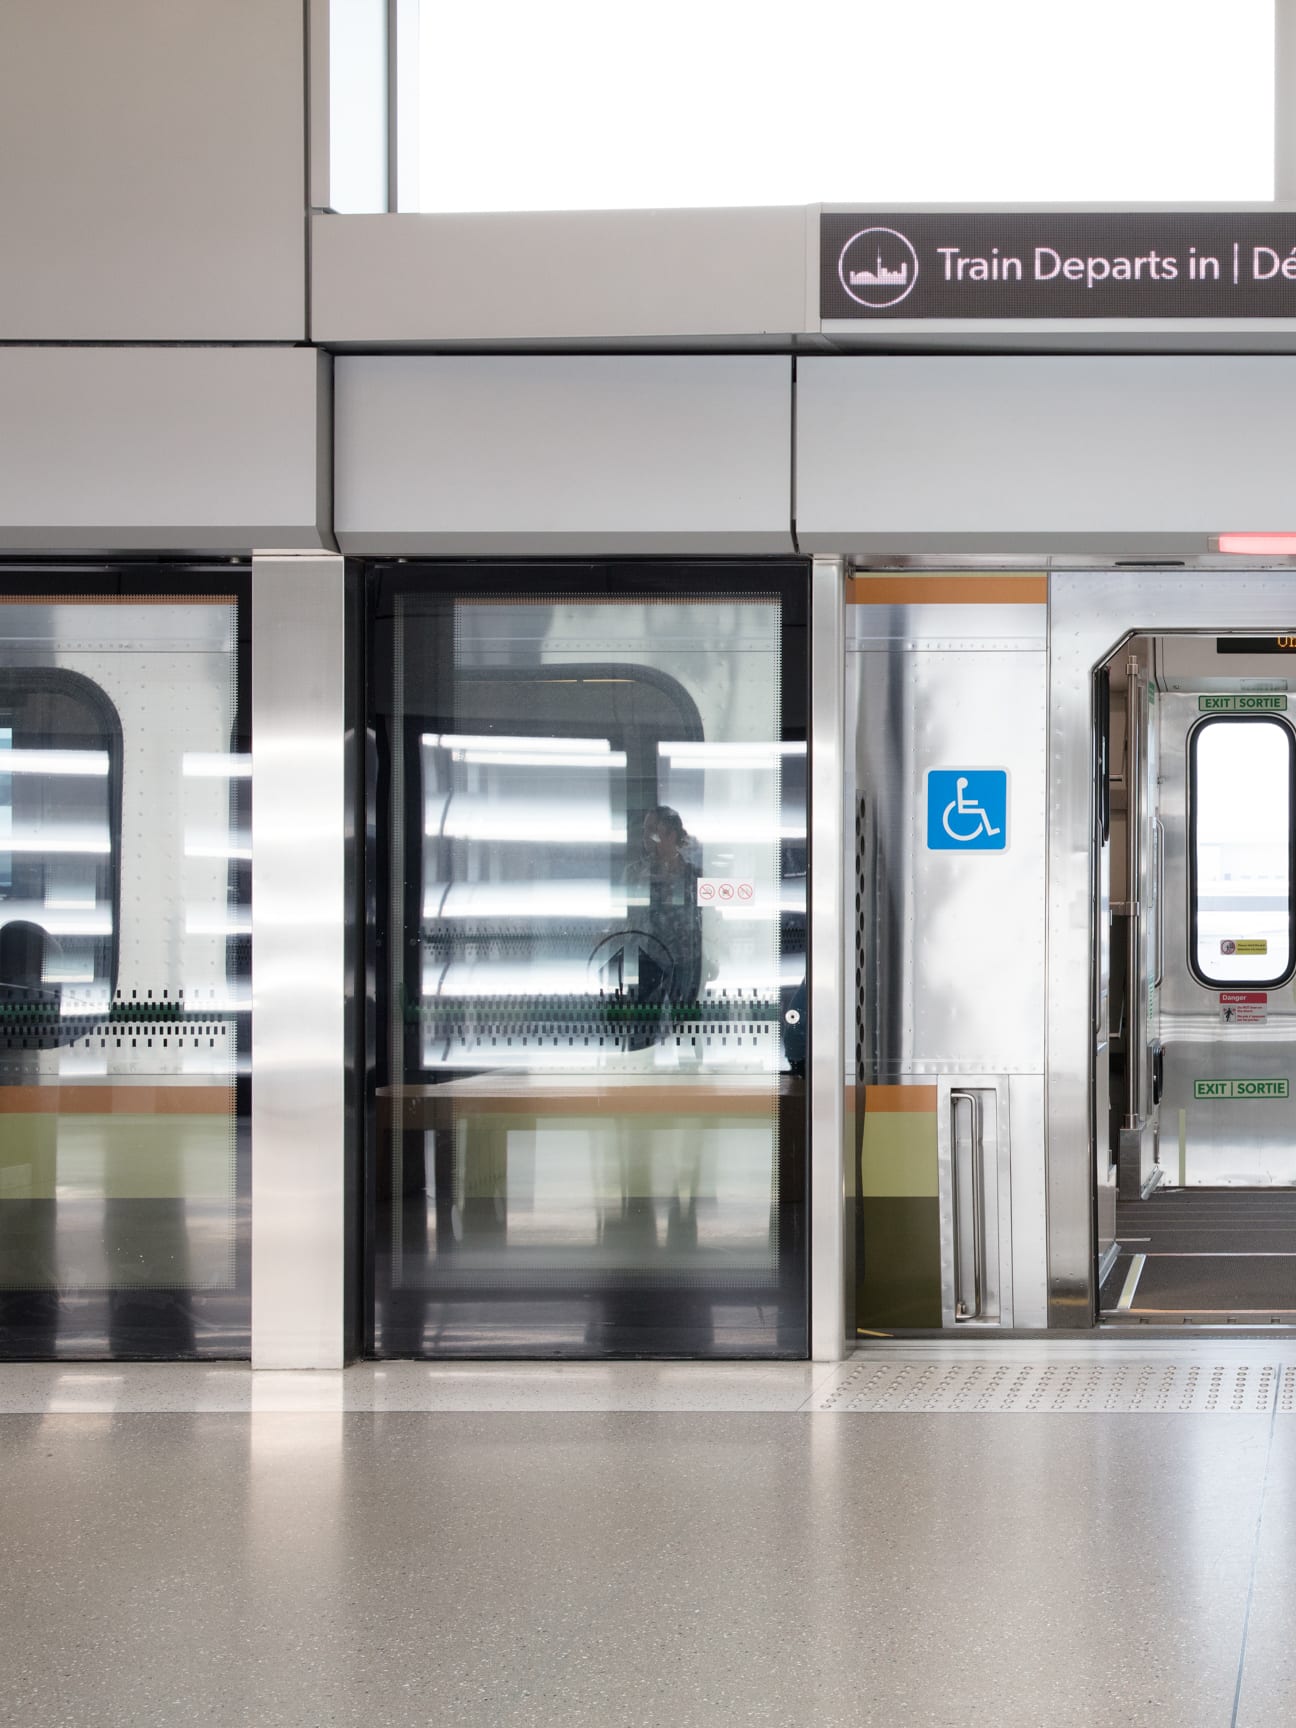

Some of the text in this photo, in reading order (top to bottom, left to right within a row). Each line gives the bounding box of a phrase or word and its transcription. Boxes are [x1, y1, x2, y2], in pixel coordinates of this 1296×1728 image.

[936, 246, 1022, 281] Train
[1034, 246, 1178, 288] Departs
[1189, 246, 1220, 281] in
[1205, 698, 1281, 708] EXIT SORTIE
[1222, 994, 1247, 1002] Danger
[1198, 1083, 1285, 1094] EXIT SORTIE
